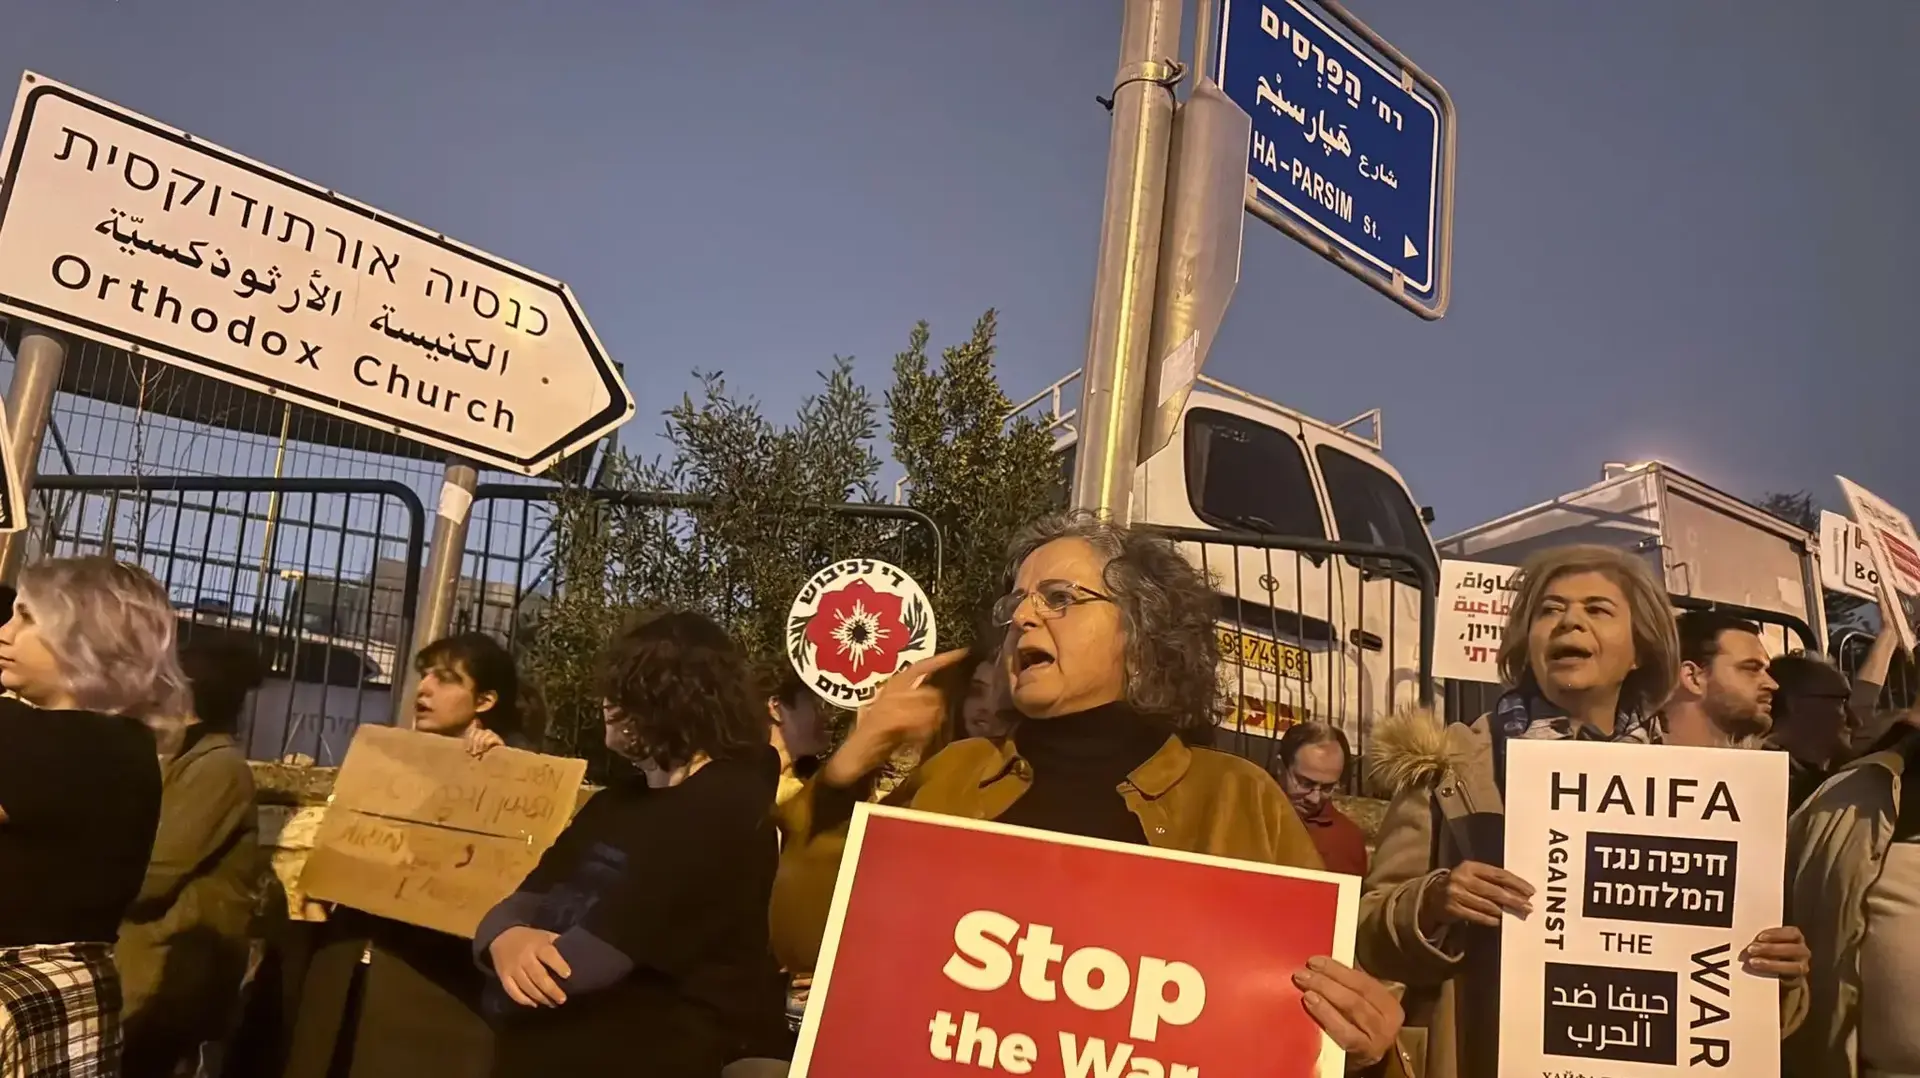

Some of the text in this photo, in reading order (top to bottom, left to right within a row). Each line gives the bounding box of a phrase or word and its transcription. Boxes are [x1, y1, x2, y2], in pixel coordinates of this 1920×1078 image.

[1252, 130, 1381, 241] HA-PARSIM St.
[1358, 154, 1398, 190] شارع
[53, 126, 549, 337] כנסיה אורתודוקסית
[51, 253, 516, 433] Orthodox Church
[369, 304, 510, 376] الكنيسة
[799, 559, 905, 606] די לכיבוש
[1453, 595, 1511, 618] ماعية
[1464, 645, 1501, 664] רתי
[1550, 772, 1741, 823] HAIFA
[1594, 846, 1728, 877] חיפה נגד
[1544, 828, 1569, 951] AGAINST
[1592, 880, 1725, 913] המלחמה
[1600, 931, 1653, 955] THE
[942, 909, 1206, 1042] Stop
[1551, 982, 1669, 1020] حيفا ضد
[1689, 942, 1732, 1068] WAR
[928, 1010, 1038, 1074] the
[1567, 1021, 1651, 1051] الحرب
